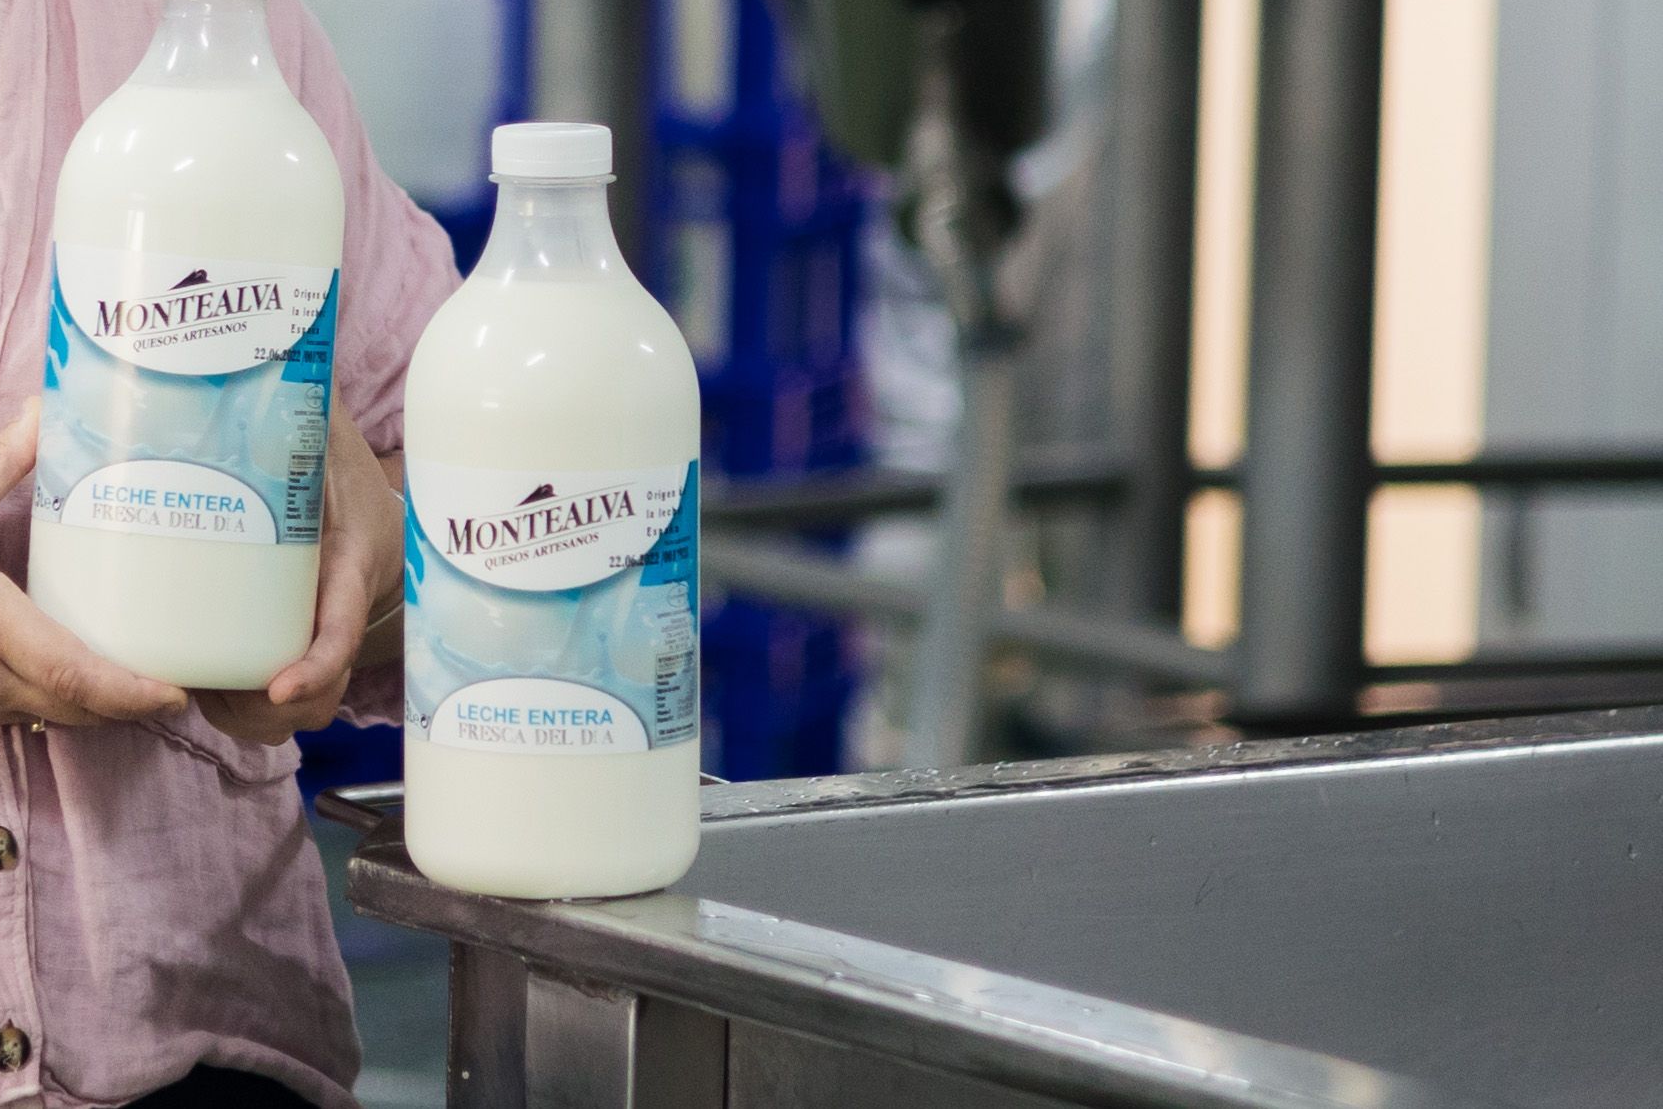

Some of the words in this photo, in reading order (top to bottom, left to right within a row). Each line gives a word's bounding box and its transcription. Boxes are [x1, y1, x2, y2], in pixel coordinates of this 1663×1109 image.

[93, 282, 284, 337] MONTEALVA
[133, 332, 179, 353] QUESOS
[181, 321, 248, 343] ARTESANOS
[92, 483, 156, 506] LECHE
[164, 491, 246, 513] ENTERA
[92, 502, 160, 526] FRESCA
[169, 511, 207, 531] DEL
[446, 489, 636, 556] MONTEALVA
[484, 550, 530, 571] QUESOS
[532, 531, 600, 560] ARTESANOS
[457, 703, 520, 724] LECHE
[528, 708, 613, 726] ENTERA
[458, 722, 526, 744] FRESCA
[535, 728, 574, 746] DEL
